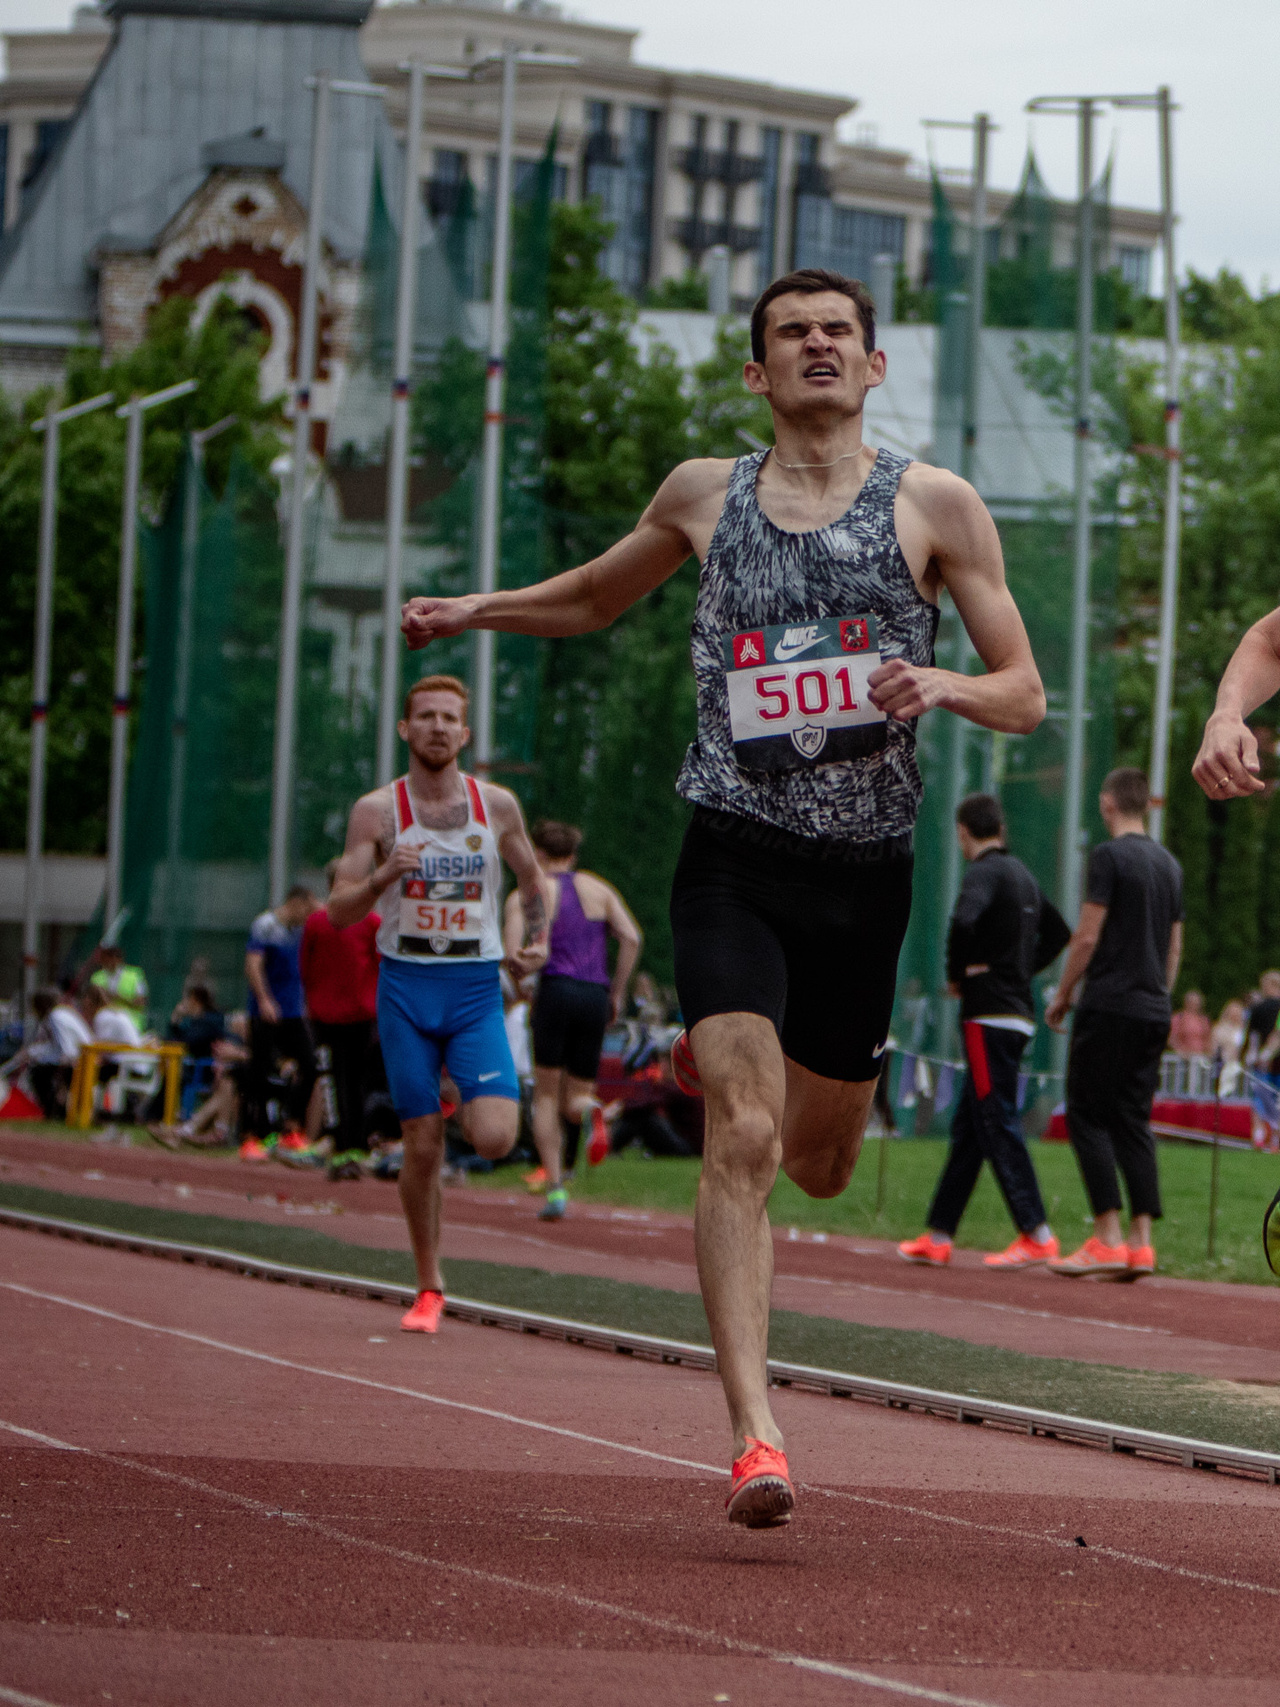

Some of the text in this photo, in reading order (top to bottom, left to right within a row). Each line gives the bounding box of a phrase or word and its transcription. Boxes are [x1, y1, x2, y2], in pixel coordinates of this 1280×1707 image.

[781, 625, 819, 646] NIKE
[754, 666, 859, 721] 501
[416, 905, 466, 931] 514
